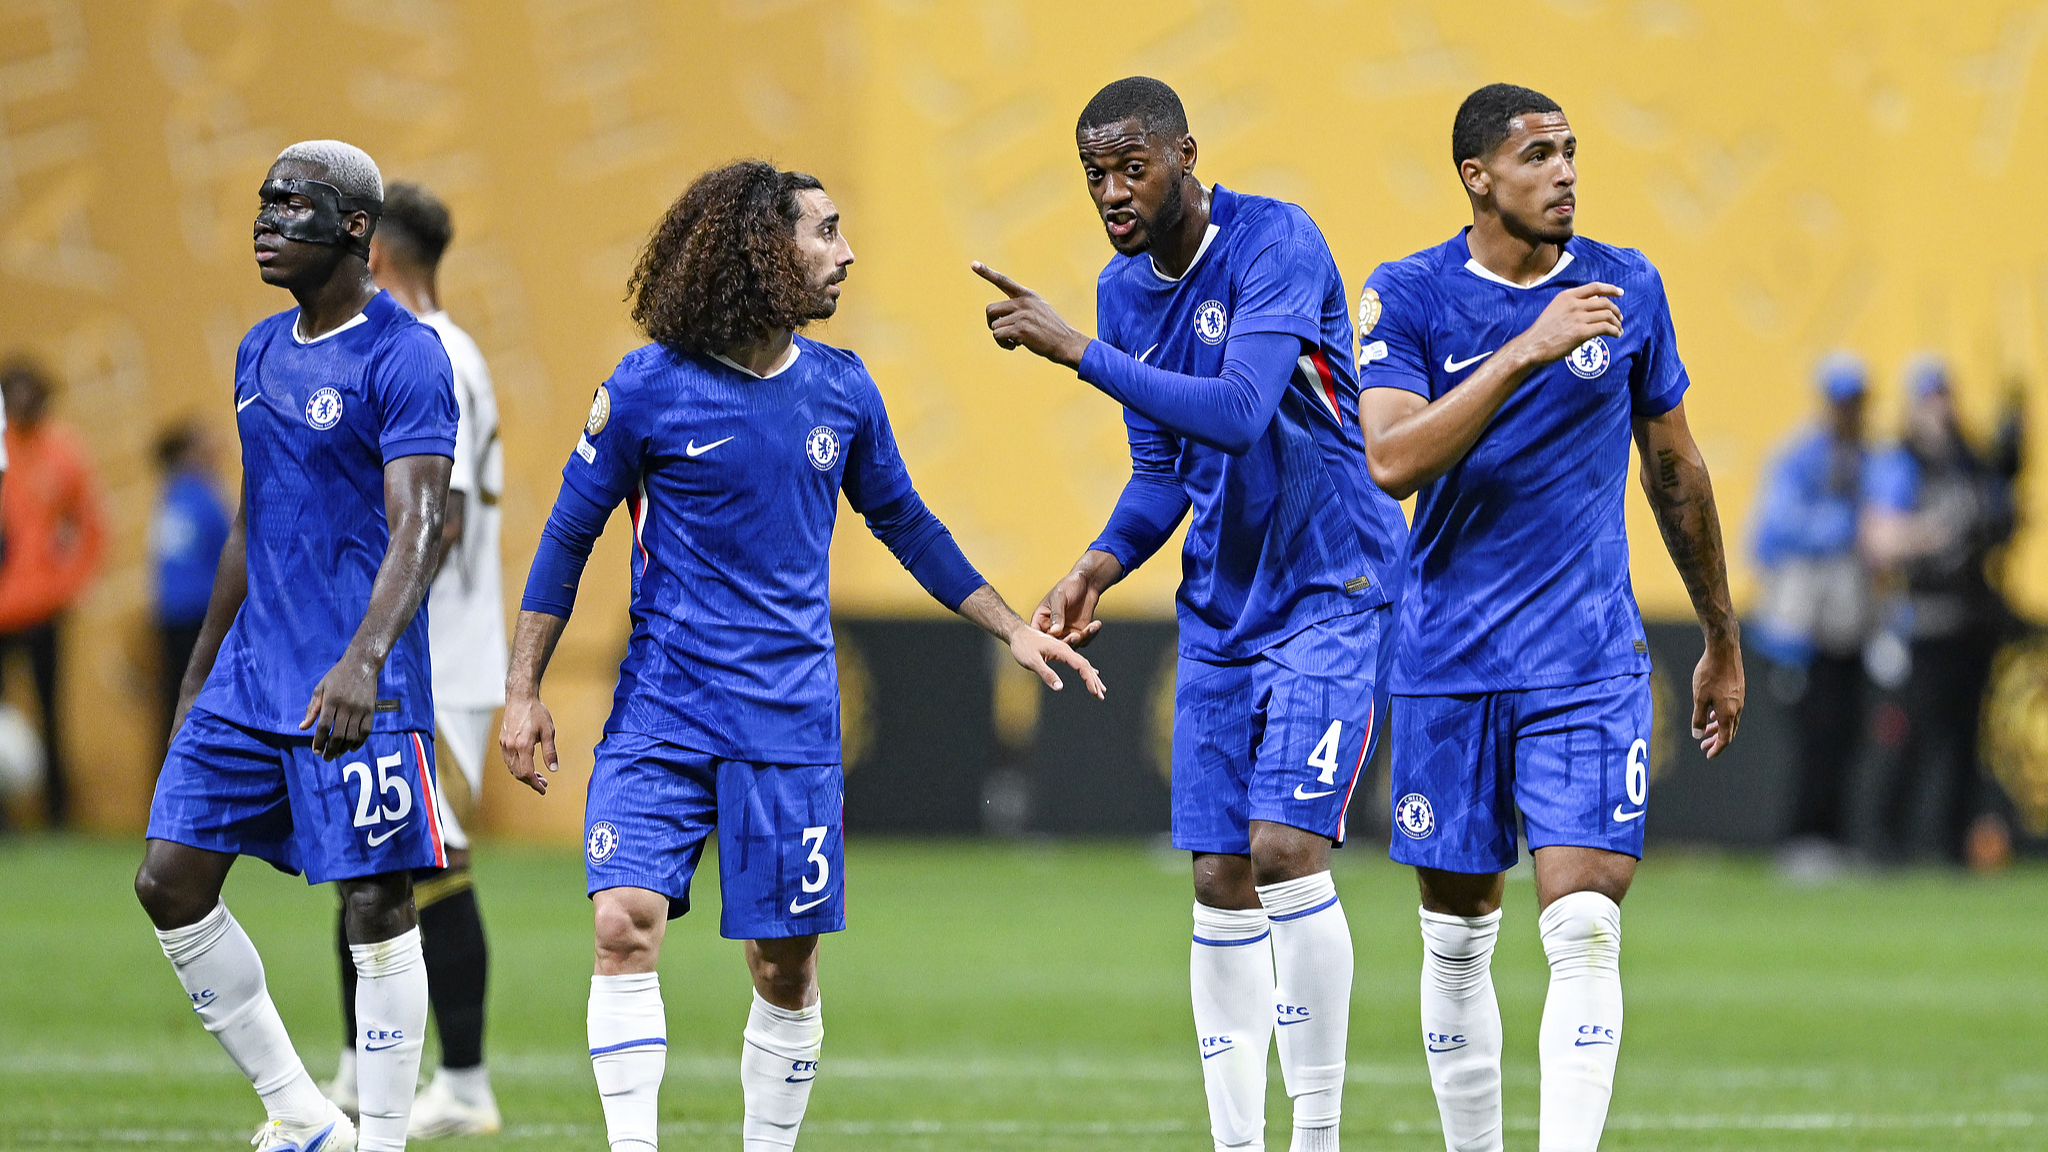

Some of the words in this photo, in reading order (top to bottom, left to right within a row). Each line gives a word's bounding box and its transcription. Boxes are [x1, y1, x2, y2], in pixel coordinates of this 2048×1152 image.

[1307, 719, 1342, 786] 4
[1626, 738, 1647, 806] 6
[342, 750, 412, 828] 25
[802, 825, 829, 893] 3
[187, 989, 215, 1001] FC
[1276, 1003, 1310, 1016] CFC
[366, 1030, 404, 1040] CFC
[1428, 1032, 1467, 1043] CFC
[1578, 1024, 1614, 1040] CFC
[1202, 1035, 1233, 1048] CFC
